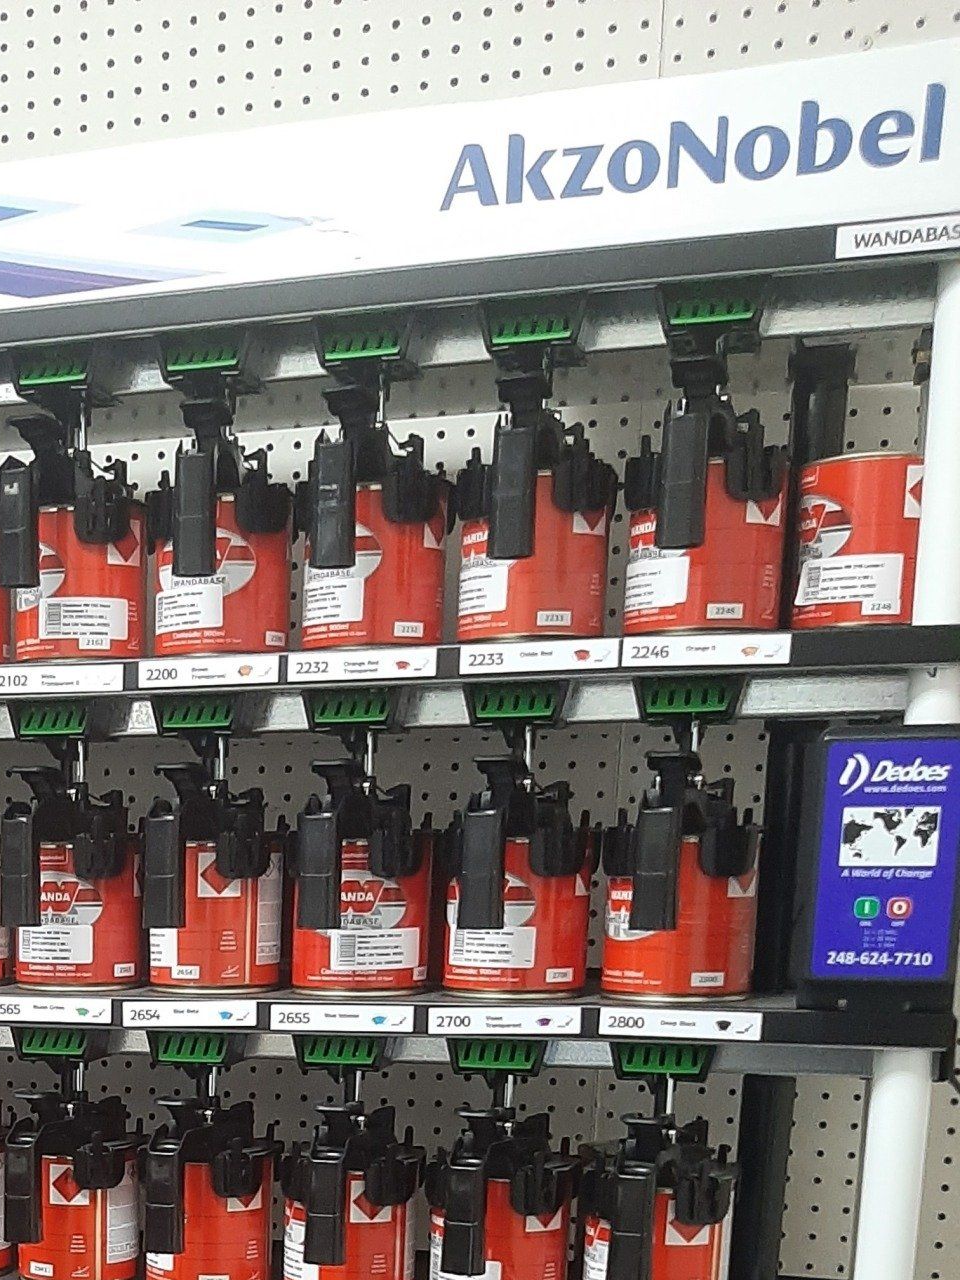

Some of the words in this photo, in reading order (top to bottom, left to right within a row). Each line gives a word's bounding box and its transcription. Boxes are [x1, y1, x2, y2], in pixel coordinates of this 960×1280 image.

[440, 82, 947, 211] AkzoNobel
[174, 575, 227, 588] WANDABASE
[630, 645, 670, 659] 2246
[468, 653, 504, 667] 2233
[296, 661, 329, 674] 2232
[146, 669, 178, 681] 2200
[871, 757, 952, 783] Dedoes
[864, 784, 947, 794] www.dedoes.com
[841, 869, 850, 877] A
[852, 869, 881, 878] World
[882, 869, 893, 880] of
[895, 869, 933, 880] Change
[41, 891, 71, 903] ANDA
[341, 891, 375, 903] ANDA
[827, 951, 933, 966] 248-624-7710
[130, 1009, 161, 1021] 2654
[278, 1012, 311, 1024] 2655
[436, 1015, 471, 1028] 2700
[608, 1015, 645, 1029] 2800
